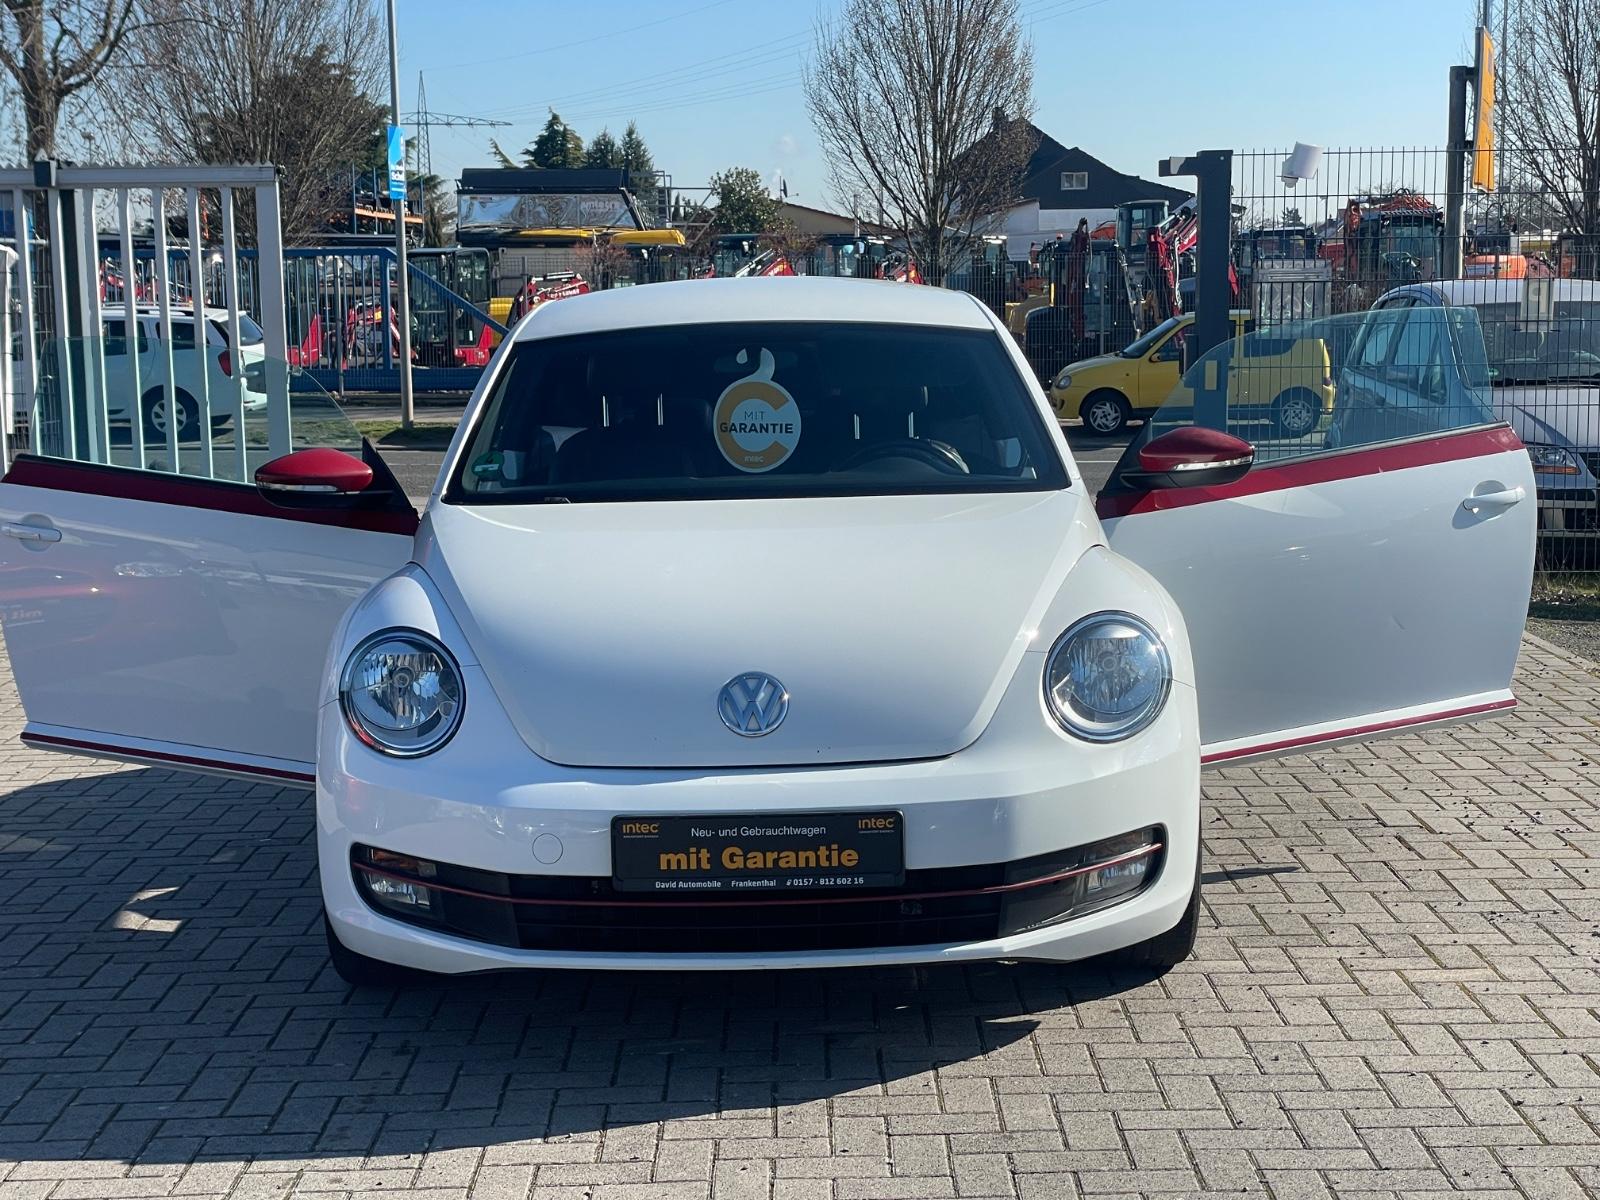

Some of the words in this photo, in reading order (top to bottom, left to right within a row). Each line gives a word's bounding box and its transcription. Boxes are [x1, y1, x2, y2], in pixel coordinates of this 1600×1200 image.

[744, 411, 765, 421] MIT
[720, 422, 794, 434] GARANTIE
[622, 822, 659, 833] intec
[858, 817, 895, 829] intec
[691, 827, 716, 838] Neu-
[718, 826, 738, 837] und
[740, 825, 827, 838] Gebrauchtwagen
[659, 847, 711, 870] mit
[721, 844, 859, 870] Garantie
[655, 880, 677, 889] David
[678, 880, 722, 889] Automobile
[731, 879, 776, 889] Frankenthal
[793, 878, 813, 886] 0157
[853, 876, 864, 885] 16
